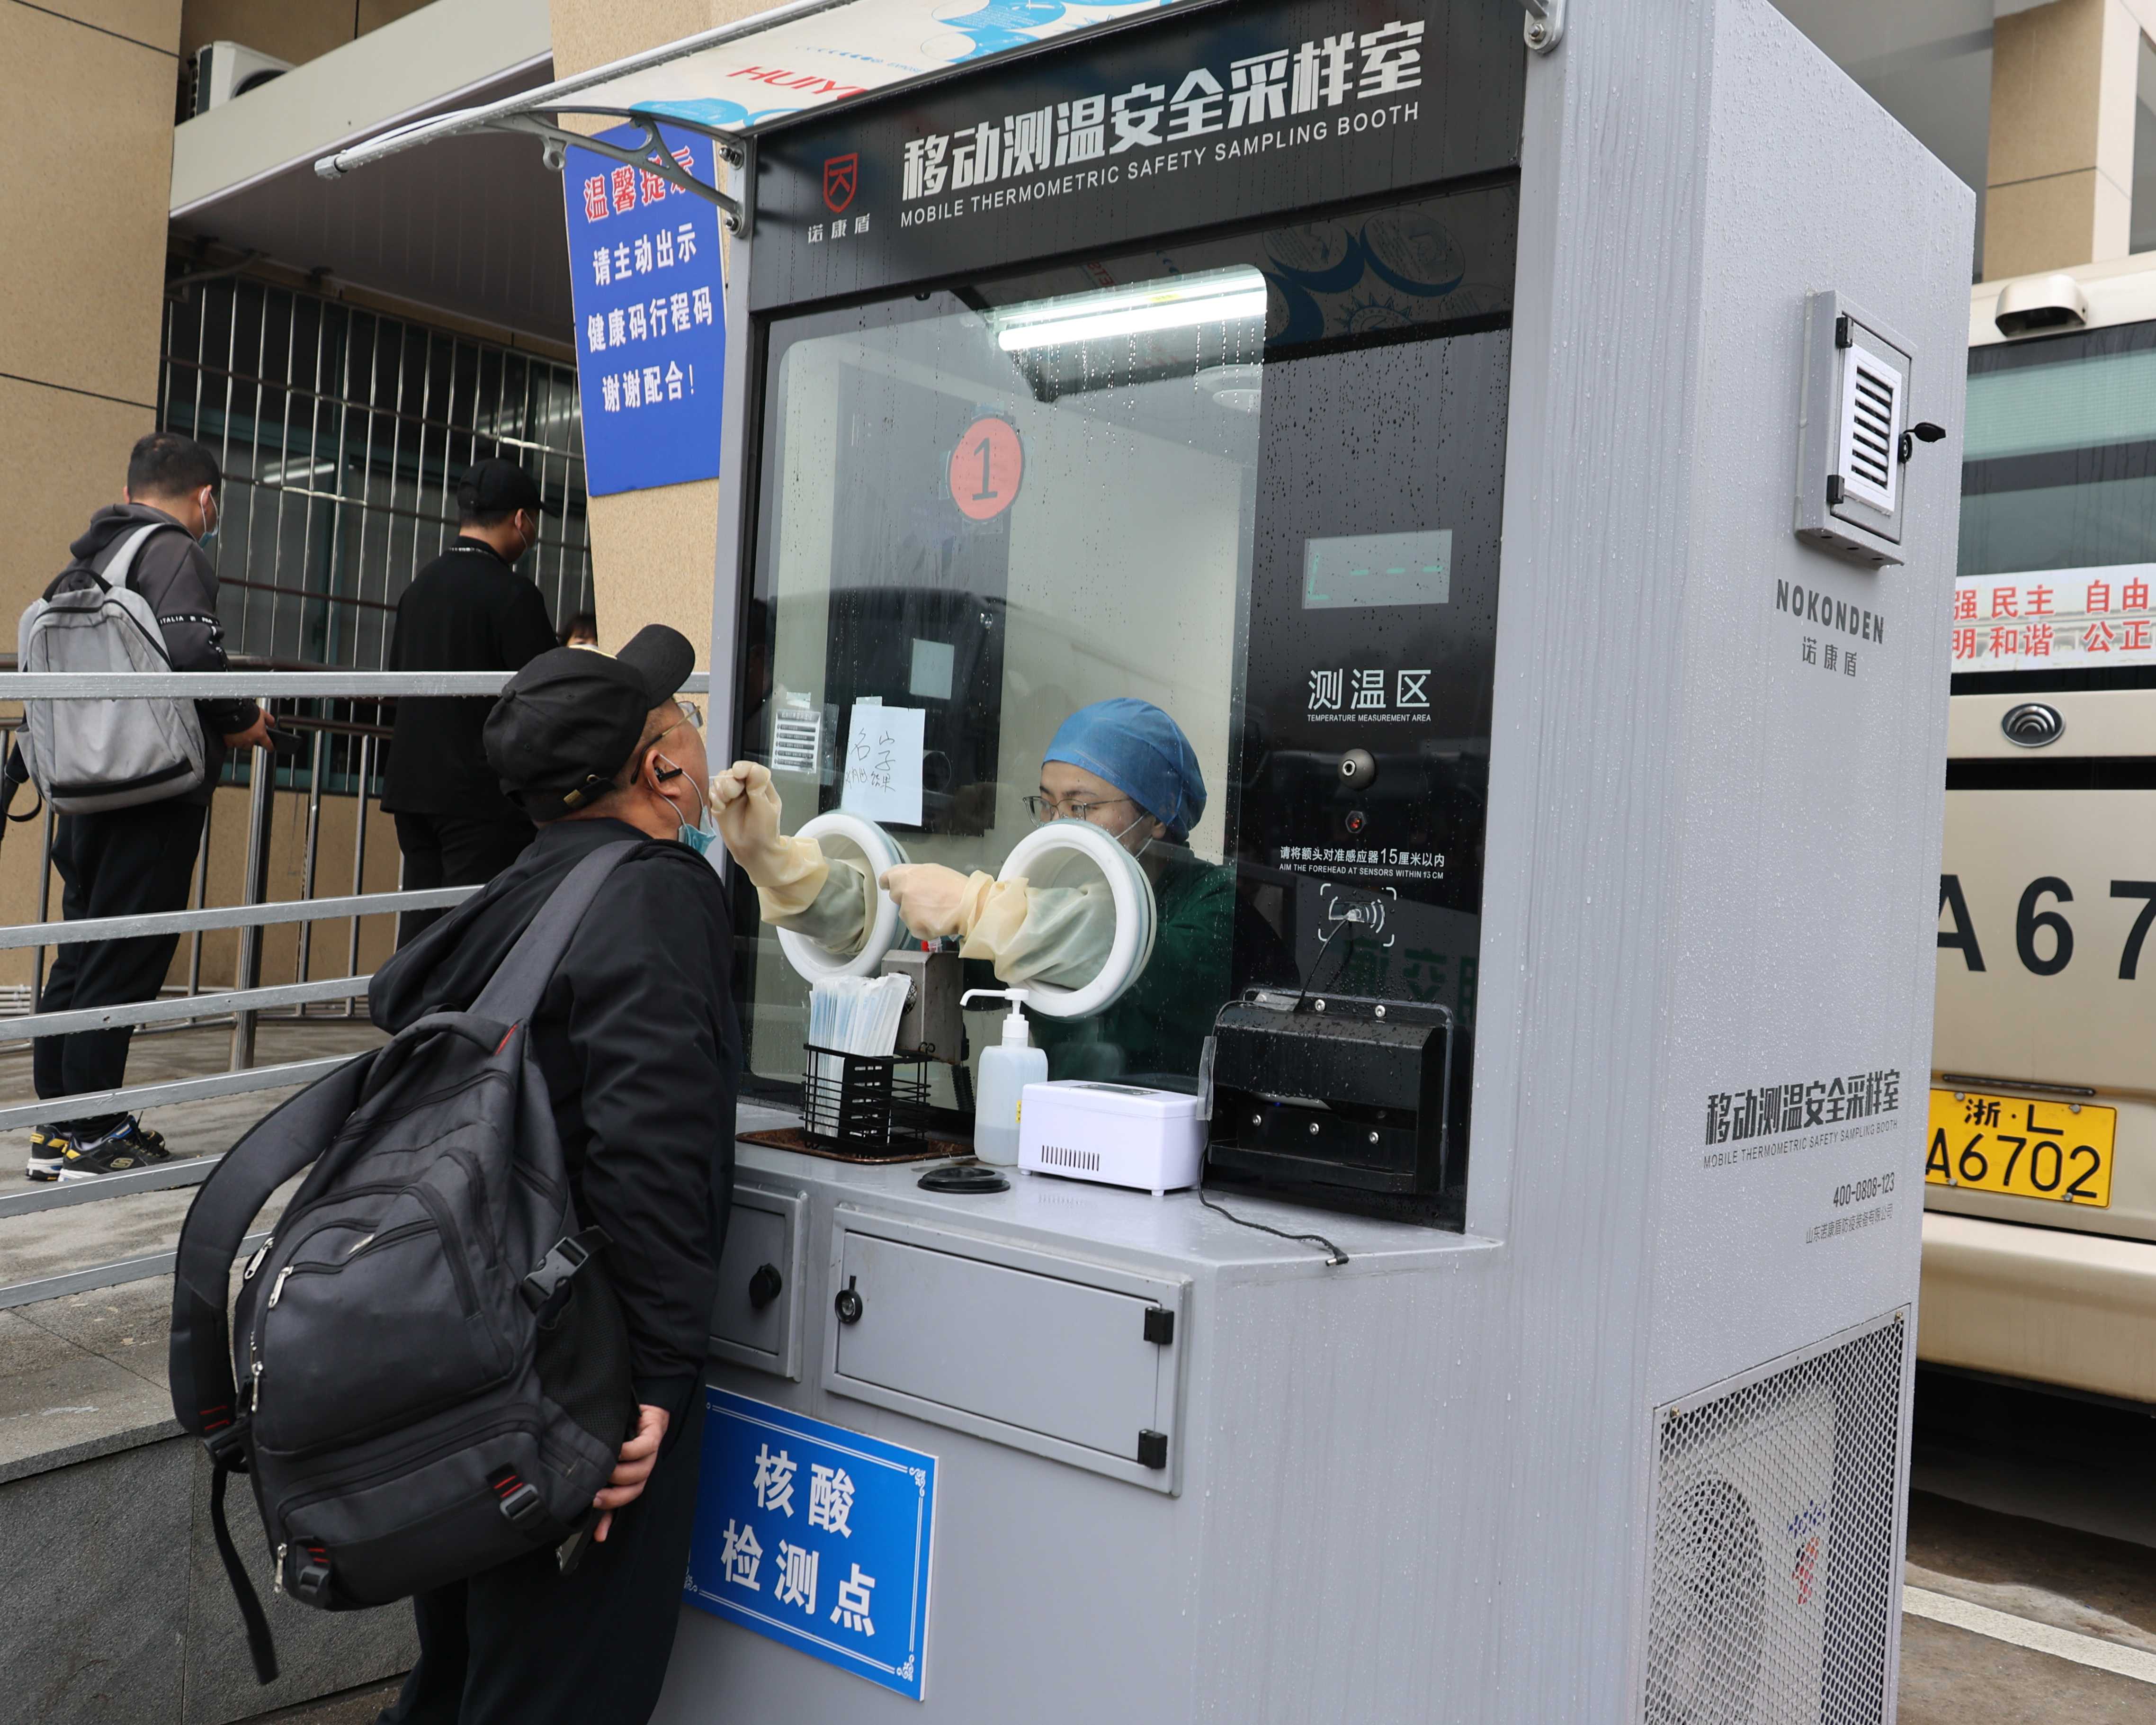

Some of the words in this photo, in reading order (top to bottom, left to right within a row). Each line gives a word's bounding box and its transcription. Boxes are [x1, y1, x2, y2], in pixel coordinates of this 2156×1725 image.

[726, 66, 869, 100] HUIY
[903, 20, 1425, 201] 移动测温安全采样室
[901, 199, 964, 227] MOBILE
[971, 166, 1118, 214] THERMOMETRIC
[1127, 147, 1207, 180] SAFETY
[1215, 121, 1327, 162] SAMPLING
[1338, 101, 1418, 135] BOOTH
[807, 213, 870, 243] 诺康盾
[593, 222, 697, 286] 请主动出示
[588, 286, 712, 353] 健康码行程码
[602, 360, 694, 412] 谢谢配合!
[973, 437, 998, 501] 1
[160, 615, 184, 625] ITALIA
[1776, 578, 1884, 644] NOKONDEN
[2086, 577, 2149, 613] 自由
[1802, 636, 1857, 677] 诺康盾
[2083, 620, 2152, 653] 公正
[1308, 668, 1431, 710] 测温区
[1307, 714, 1356, 722] TEMPERATURE
[1358, 714, 1410, 722] MEASUREMENT
[1412, 714, 1431, 722] AREA
[1280, 846, 1445, 867] 请将额头对准感应器15厘米以内
[1294, 864, 1306, 872] THE
[1309, 865, 1346, 874] FOREHEAD
[1360, 868, 1394, 877] SENSORS
[1396, 870, 1421, 878] WITHIN
[1705, 1069, 1901, 1145] 移动测温安全采样室
[1704, 1150, 1737, 1169] MOBILE
[1742, 1137, 1807, 1161] THERMOMETRIC
[1809, 1132, 1839, 1148] SAFETY
[1841, 1122, 1875, 1142] SAMPLING
[1877, 1119, 1898, 1134] BOOTH
[1925, 1127, 2101, 1198] A6702
[1833, 1172, 1895, 1207] 400-0808-123
[753, 1443, 855, 1538] 核酸
[721, 1518, 875, 1637] 检测点
